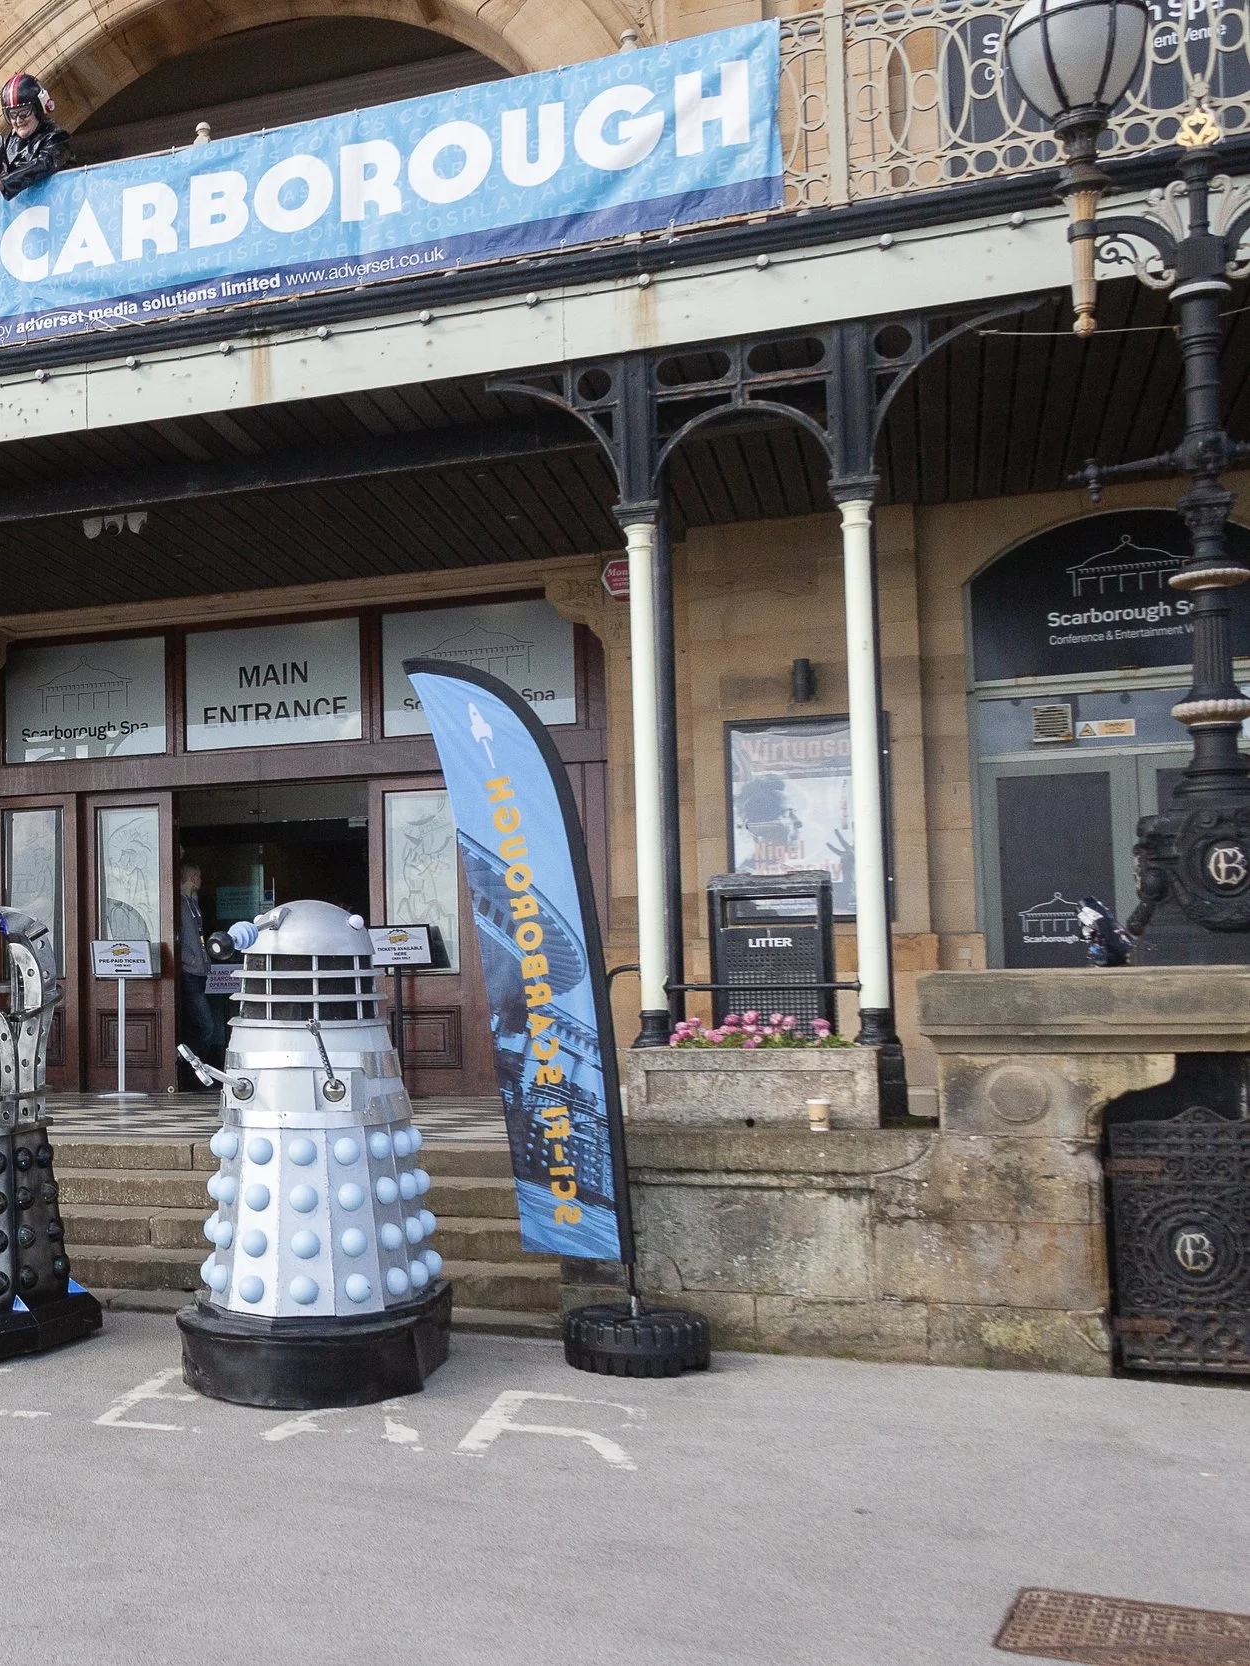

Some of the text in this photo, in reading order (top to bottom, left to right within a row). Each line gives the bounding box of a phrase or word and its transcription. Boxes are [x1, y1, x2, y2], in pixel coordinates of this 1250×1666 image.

[1184, 24, 1227, 42] Vene
[16, 311, 85, 334] adverset
[88, 300, 139, 322] media
[143, 287, 217, 311] solutions
[221, 273, 281, 297] limited
[285, 247, 444, 287] www.adverset.co.uk
[1047, 601, 1171, 628] Scarborough
[1049, 632, 1104, 646] Conference
[1105, 630, 1113, 640] &
[1115, 625, 1183, 639] Entertainment
[239, 661, 308, 688] MAIN
[521, 688, 555, 707] Spa
[204, 696, 347, 728] ENTRANCE
[21, 720, 149, 741] Scarborough Spa
[754, 840, 805, 865] Nigel
[748, 937, 793, 948] LITTER
[1022, 934, 1080, 945] Scarborough
